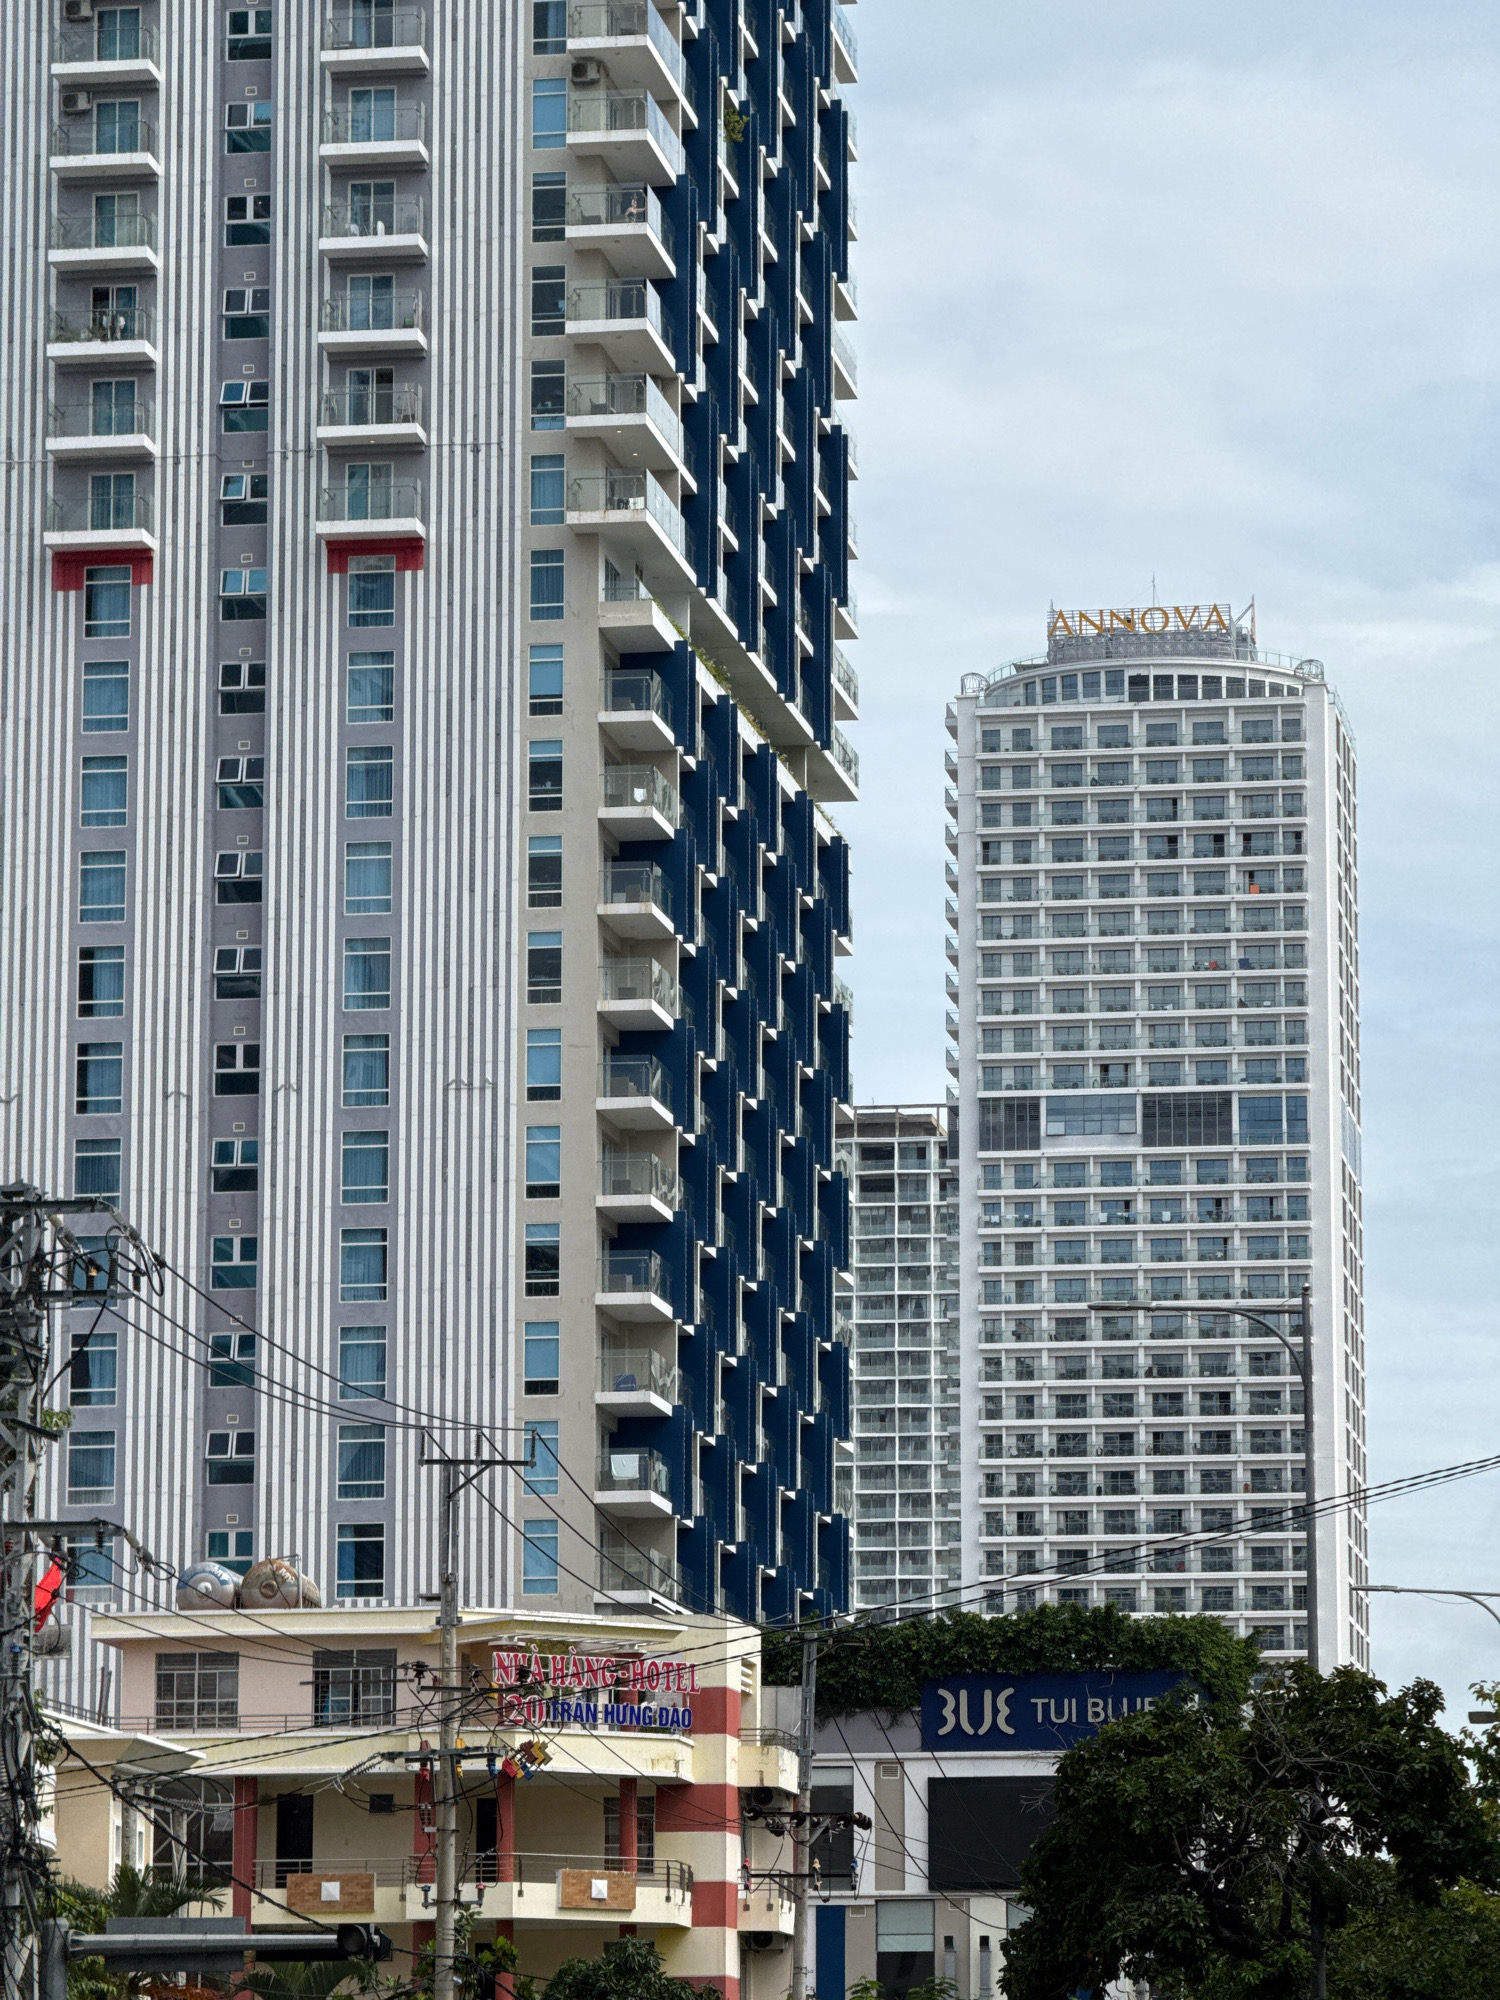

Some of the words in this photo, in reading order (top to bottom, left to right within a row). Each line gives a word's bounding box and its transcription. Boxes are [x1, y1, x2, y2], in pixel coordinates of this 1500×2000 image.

[1050, 603, 1228, 636] ANNOVA
[630, 1659, 701, 1694] HOTEL
[503, 1694, 545, 1726] 20
[603, 1701, 653, 1728] HƯNG
[1030, 1698, 1077, 1723] TUI
